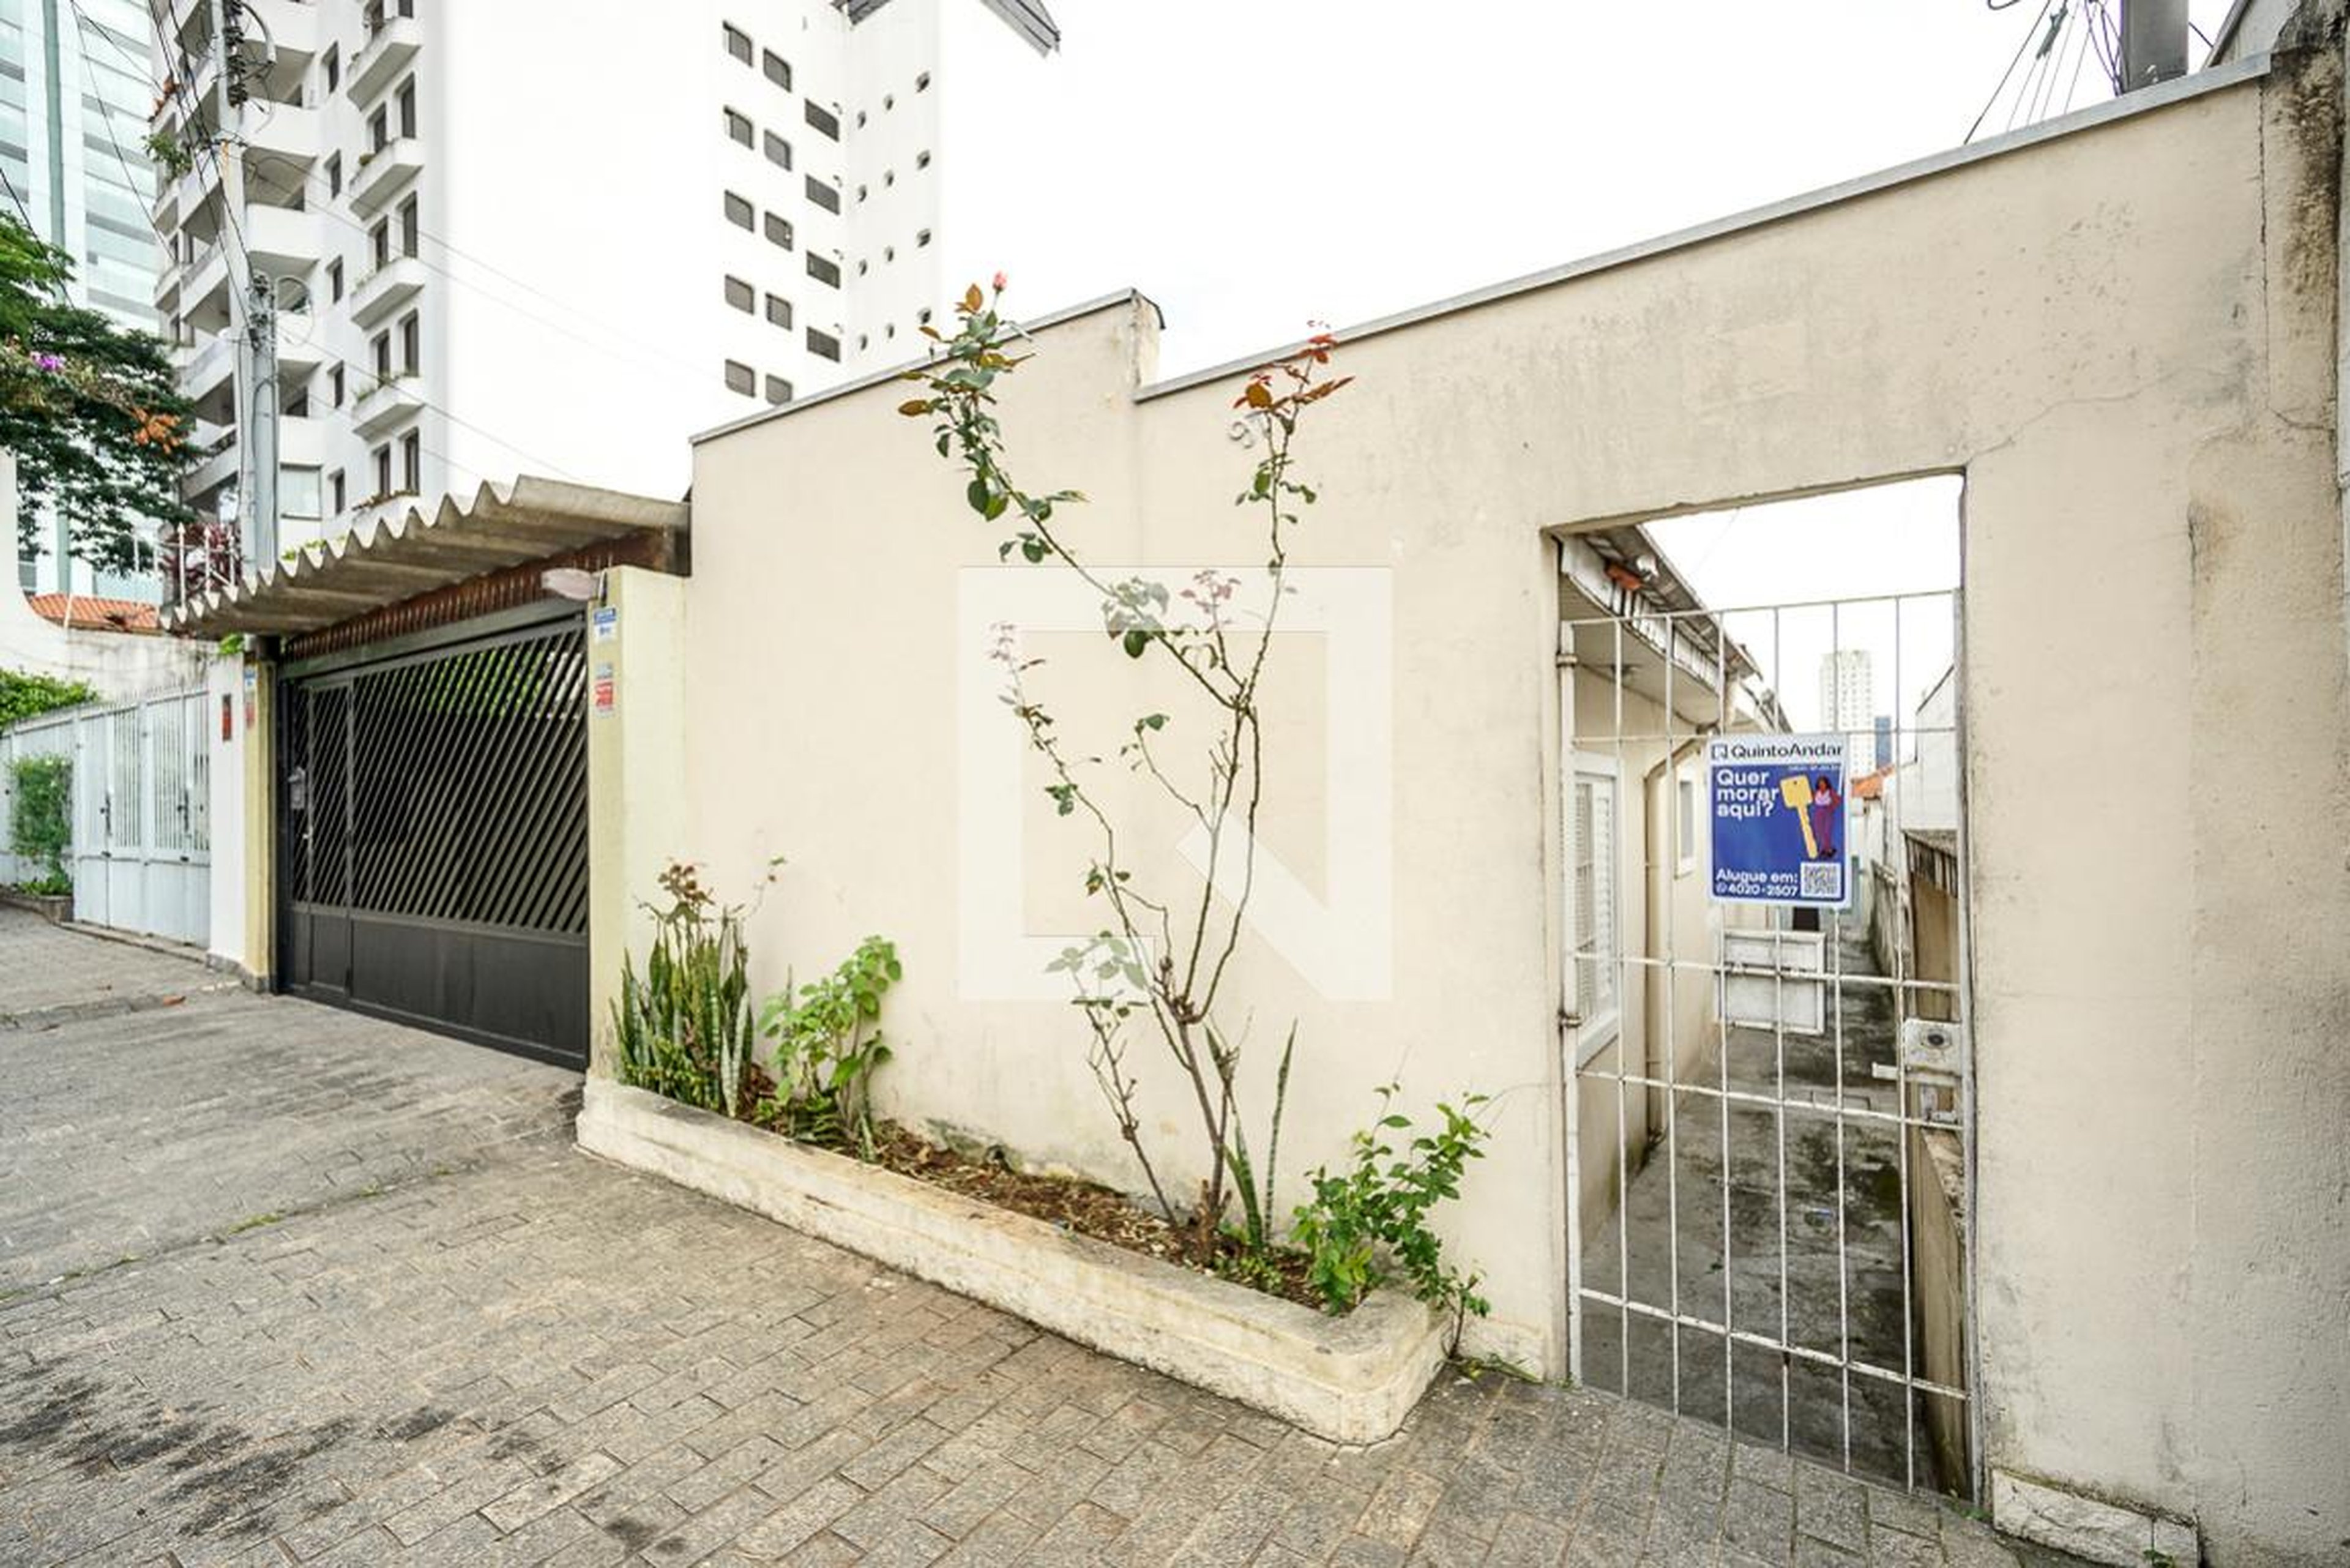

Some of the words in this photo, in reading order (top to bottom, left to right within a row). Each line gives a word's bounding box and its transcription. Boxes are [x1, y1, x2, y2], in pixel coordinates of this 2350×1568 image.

[1731, 742, 1842, 758] QuintoAndar
[1717, 768, 1770, 786] Quer
[1717, 787, 1780, 802] morar
[1717, 800, 1775, 821] aqui?
[1715, 868, 1768, 884] Alugue
[1770, 872, 1799, 884] em:
